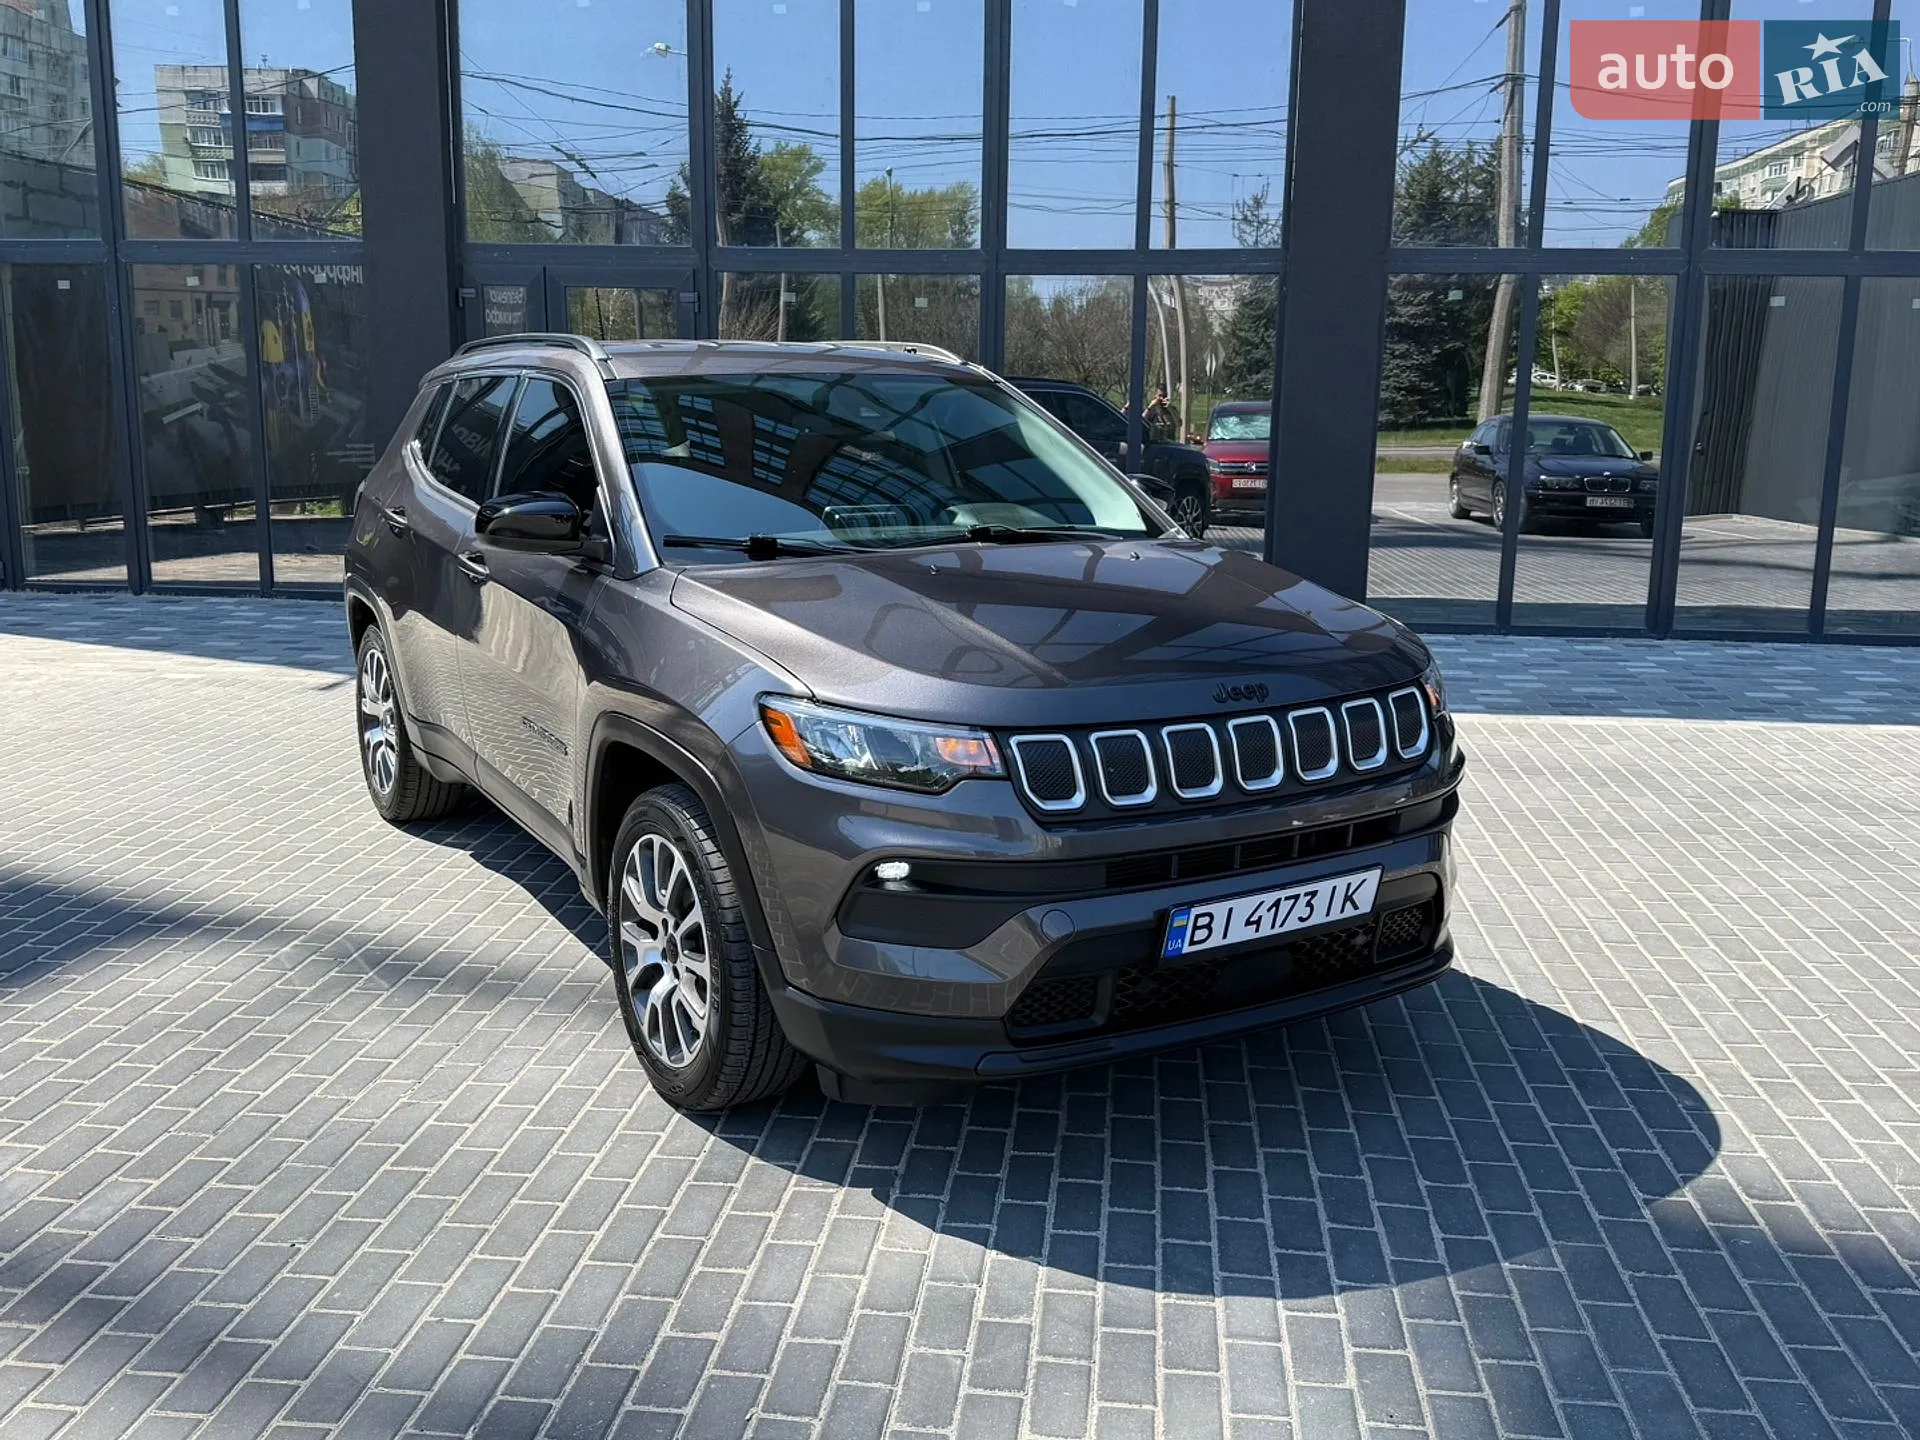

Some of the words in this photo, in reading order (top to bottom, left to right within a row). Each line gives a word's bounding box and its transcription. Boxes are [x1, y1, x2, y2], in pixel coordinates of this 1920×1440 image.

[1211, 682, 1270, 704] Jeep
[1188, 906, 1234, 947] BI
[1244, 889, 1319, 934] 4173
[1325, 878, 1368, 919] IK
[1168, 939, 1183, 951] UA
